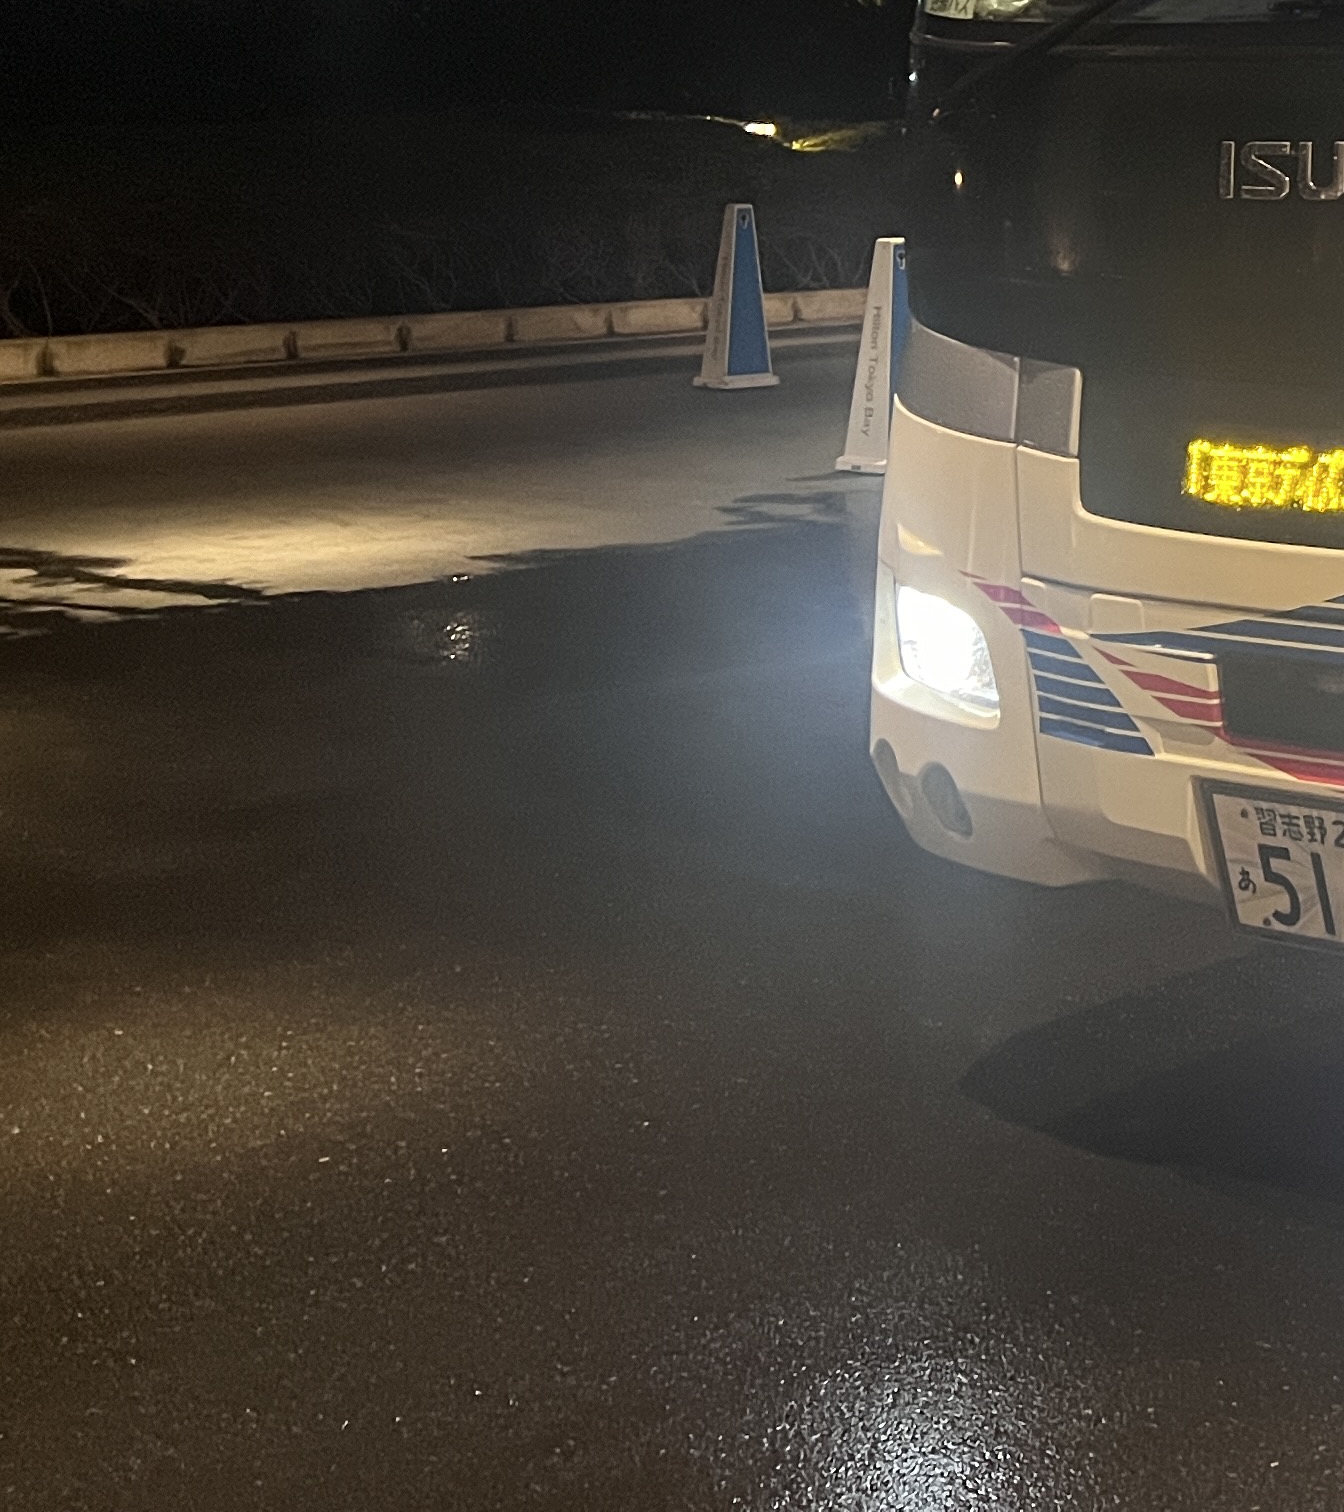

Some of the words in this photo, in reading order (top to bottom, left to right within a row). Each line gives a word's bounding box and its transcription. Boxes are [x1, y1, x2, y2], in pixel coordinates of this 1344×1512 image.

[869, 305, 883, 350] Hilton
[864, 356, 880, 403] Tokyo
[860, 406, 875, 438] Bay
[1253, 806, 1327, 846] 習志野
[1237, 866, 1257, 895] あ
